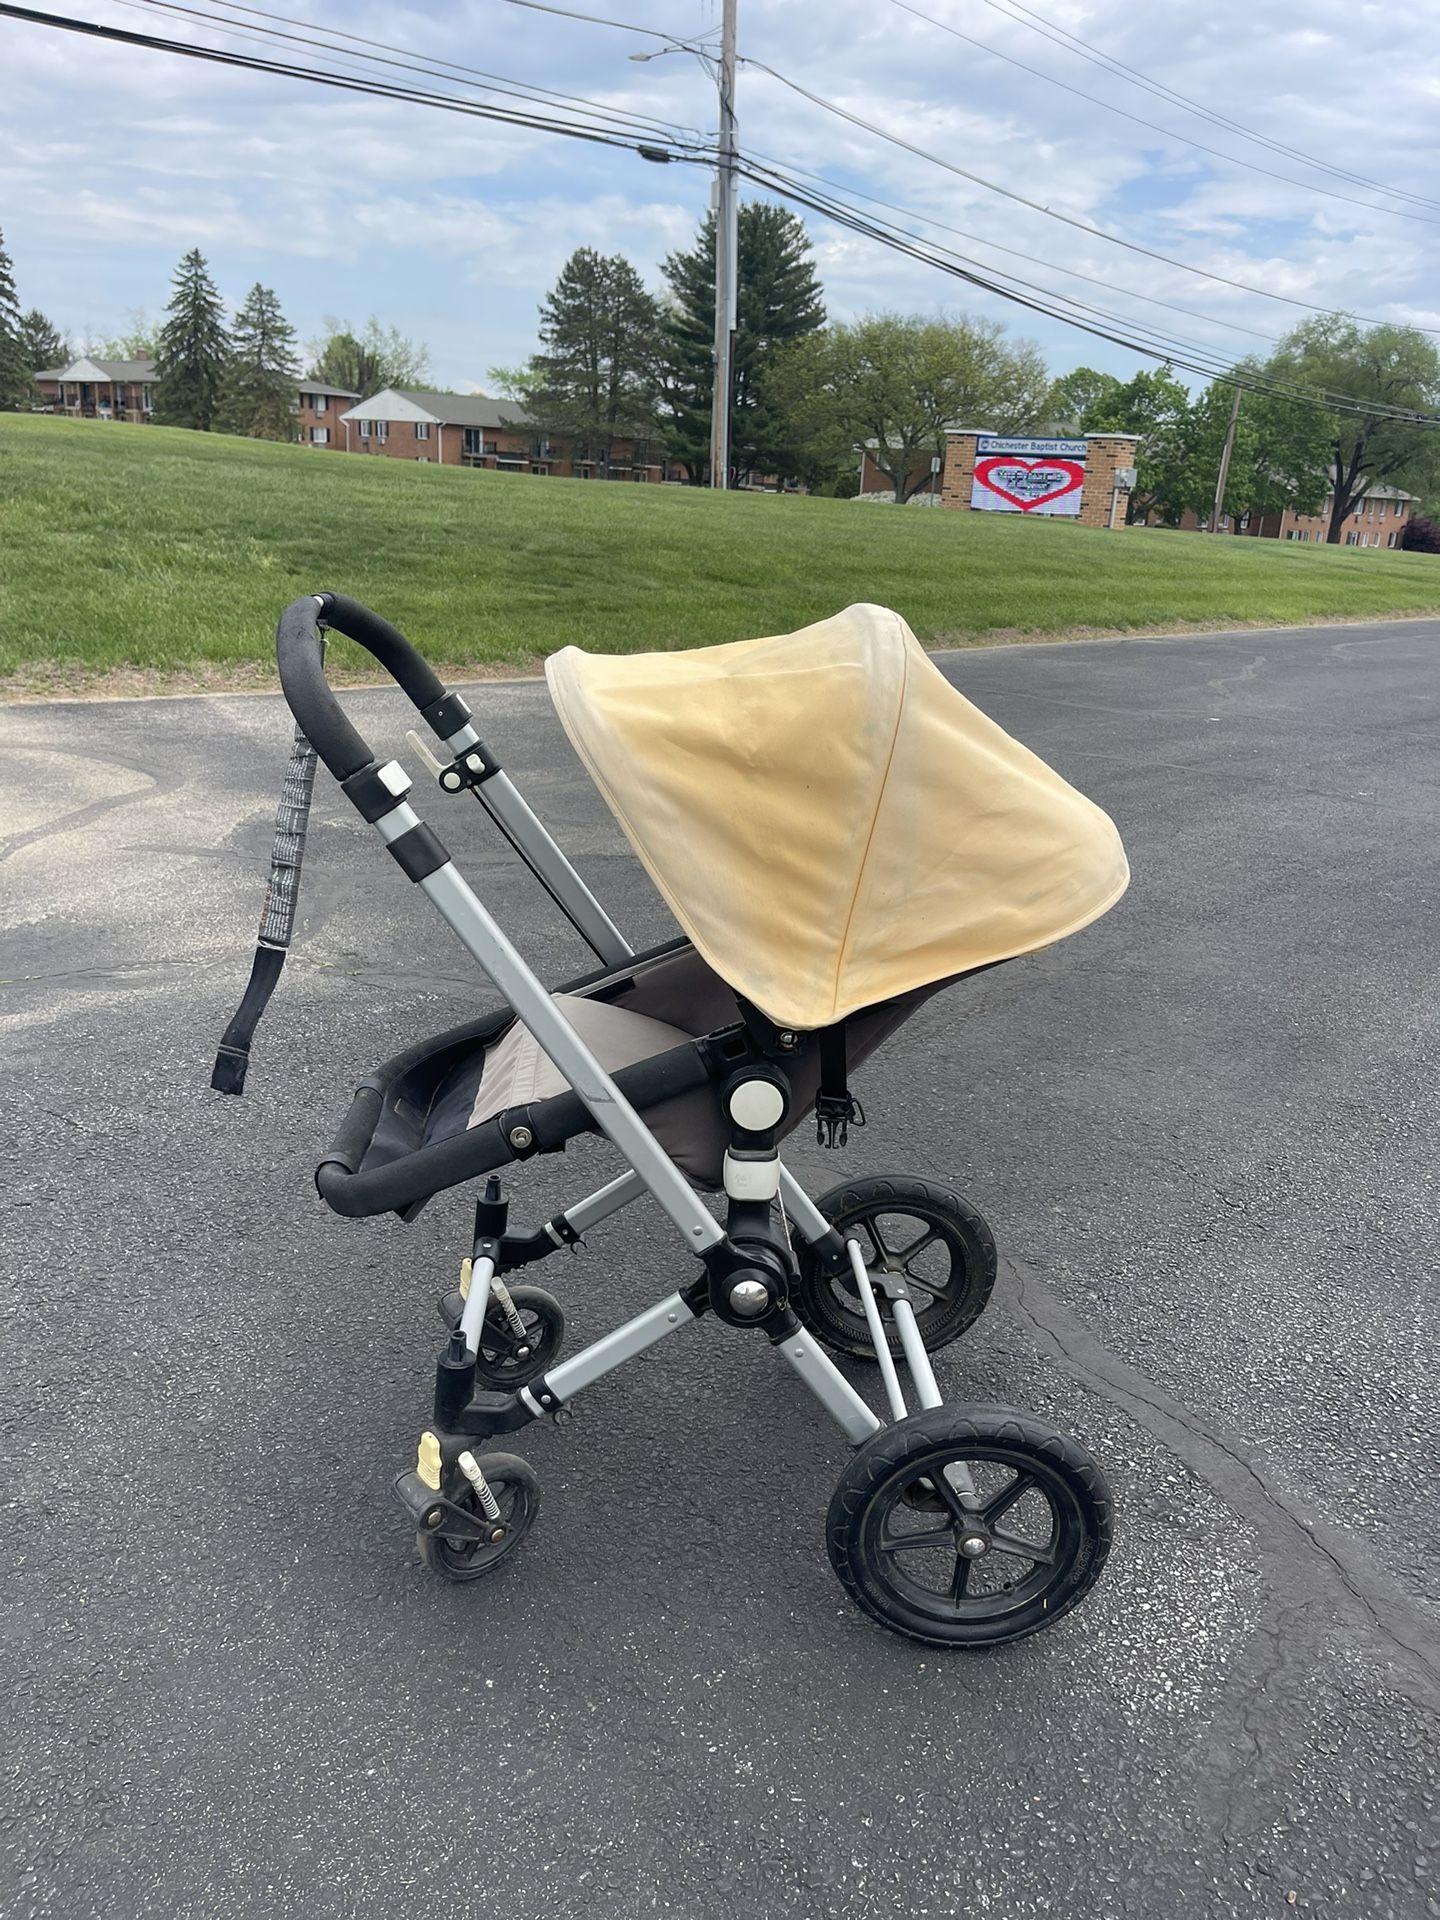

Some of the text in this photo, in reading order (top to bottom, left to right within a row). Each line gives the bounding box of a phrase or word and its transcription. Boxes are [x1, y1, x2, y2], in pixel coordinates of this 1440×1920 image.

[991, 440, 1086, 452] Chichester Baptist Church
